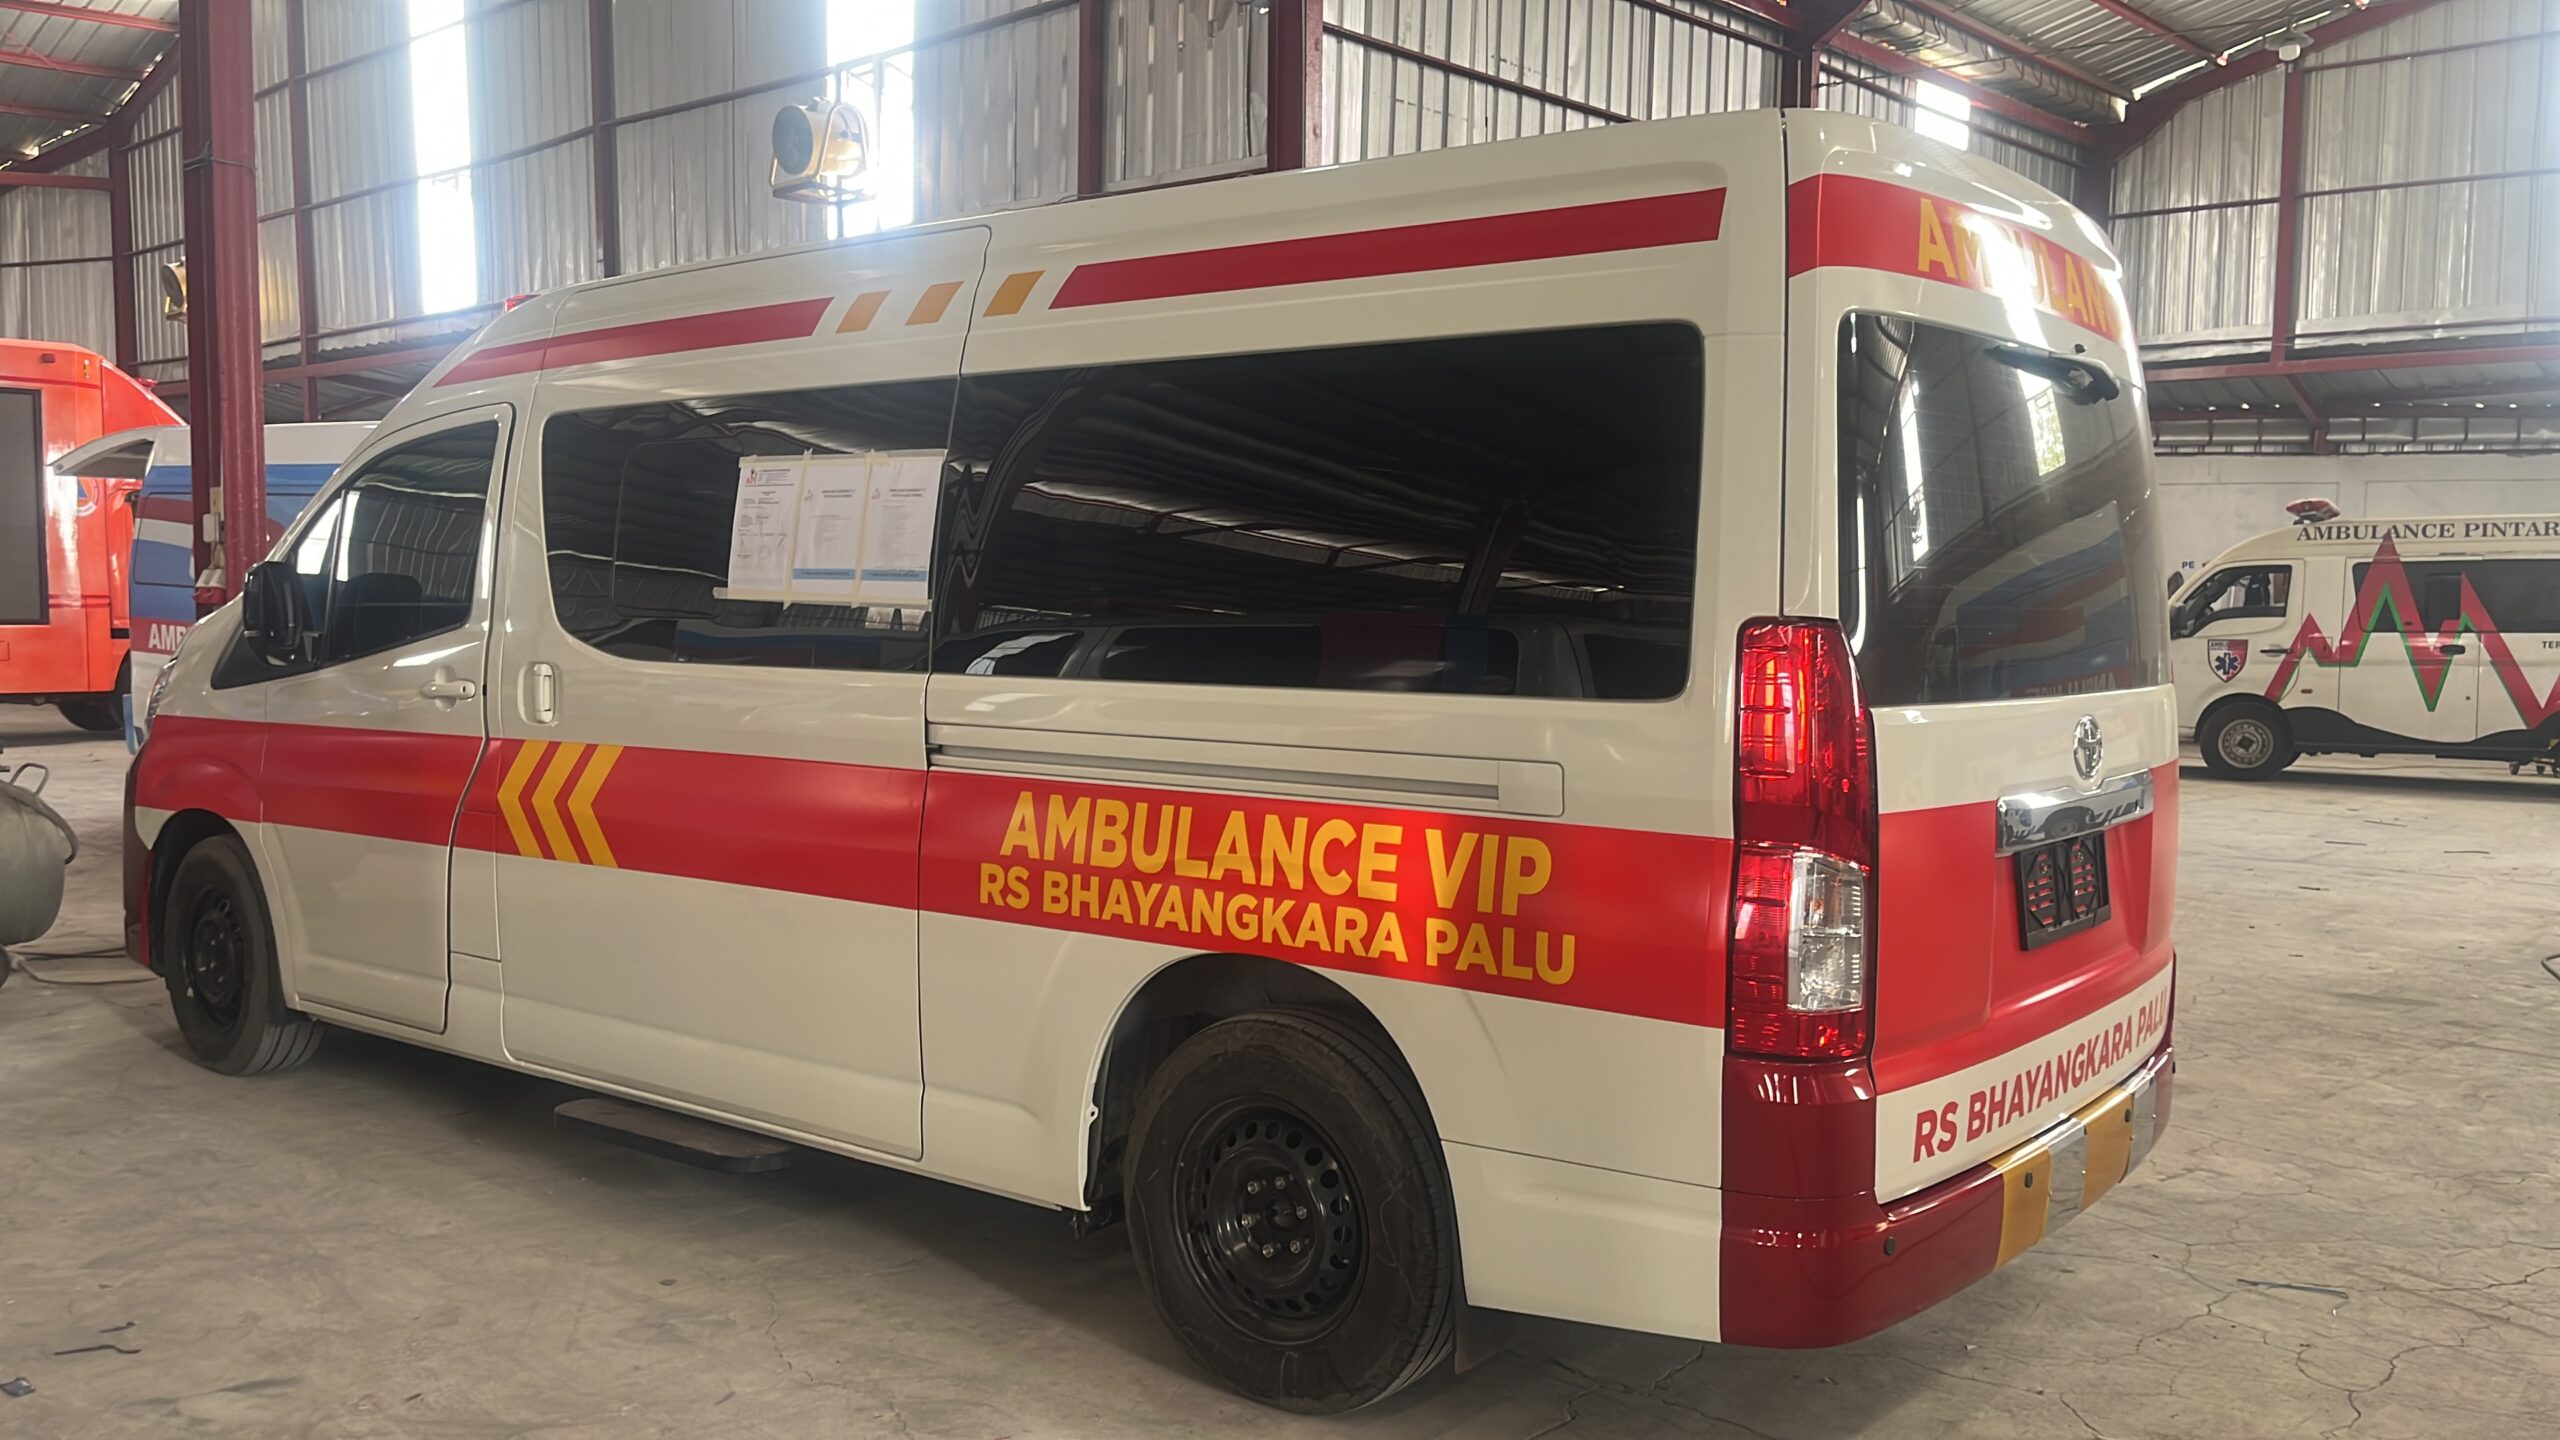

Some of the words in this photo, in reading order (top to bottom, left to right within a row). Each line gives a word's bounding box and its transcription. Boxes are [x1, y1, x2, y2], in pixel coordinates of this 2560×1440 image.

[2297, 523, 2455, 541] AMBULANCE
[2463, 521, 2560, 538] PINTAR
[1000, 791, 1403, 902] AMBULANCE
[1425, 828, 1552, 916] VIP
[979, 862, 1030, 910] RS
[1043, 870, 1409, 963] BHAYANGKARA
[1426, 917, 1576, 985] PALU
[1912, 1101, 1959, 1164] RS
[1966, 1015, 2133, 1143] BHAYANGKARA
[2136, 986, 2168, 1048] PALU
